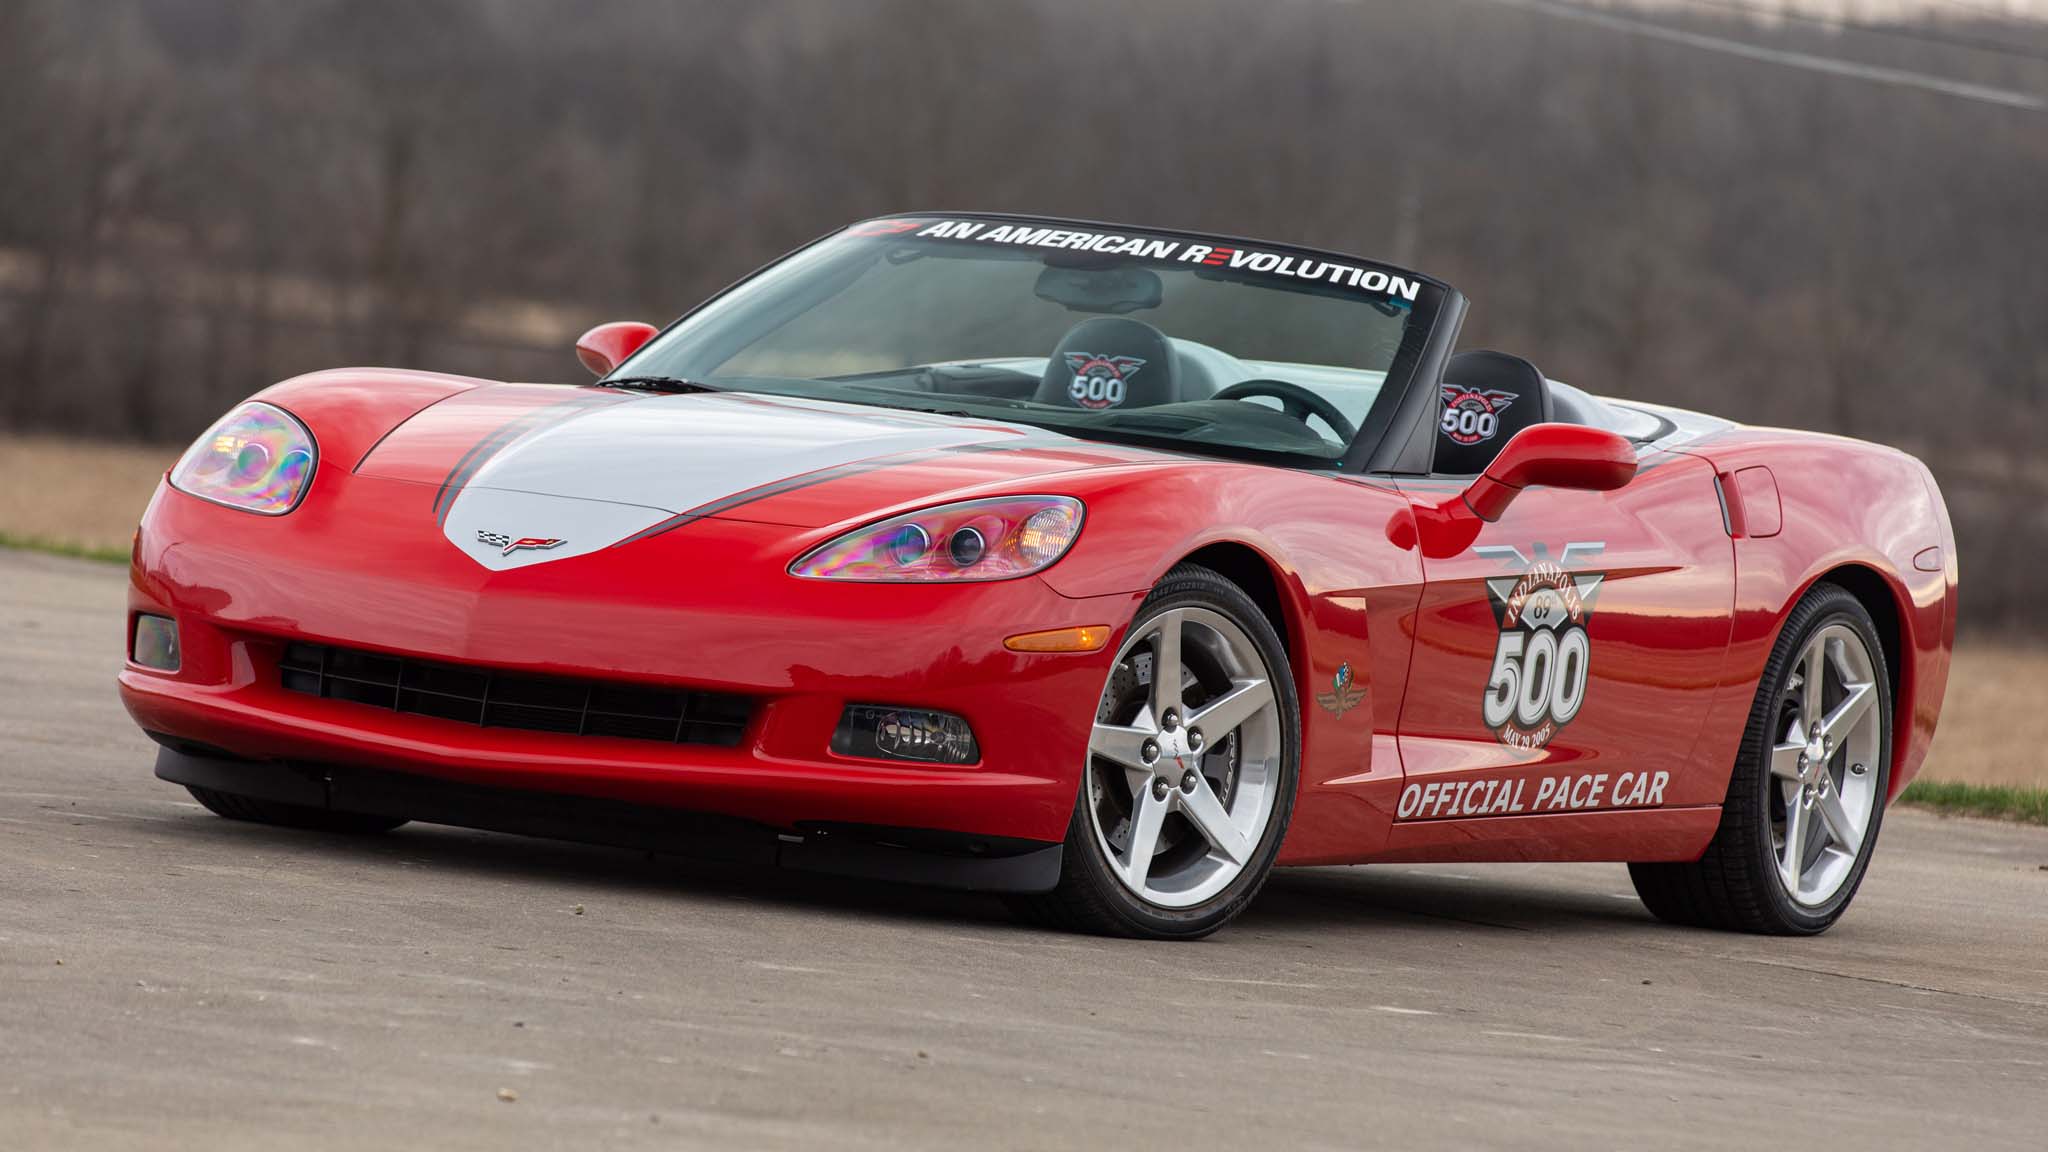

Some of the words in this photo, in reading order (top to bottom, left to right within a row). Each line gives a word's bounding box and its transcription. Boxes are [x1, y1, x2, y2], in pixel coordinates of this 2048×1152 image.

[916, 221, 985, 240] AN
[976, 225, 1180, 259] AMERICAN
[1178, 246, 1421, 301] REVOLUTION
[1071, 375, 1126, 402] 500
[1440, 408, 1496, 437] 500
[1508, 562, 1581, 623] INDIANAPOLIS
[1484, 628, 1589, 727] 500
[1503, 723, 1522, 749] MAY
[1520, 735, 1530, 751] 29
[1531, 722, 1551, 749] 2005
[1397, 778, 1526, 818] OFFICIAL
[1531, 773, 1609, 810] PACE
[1611, 771, 1670, 806] CAR
